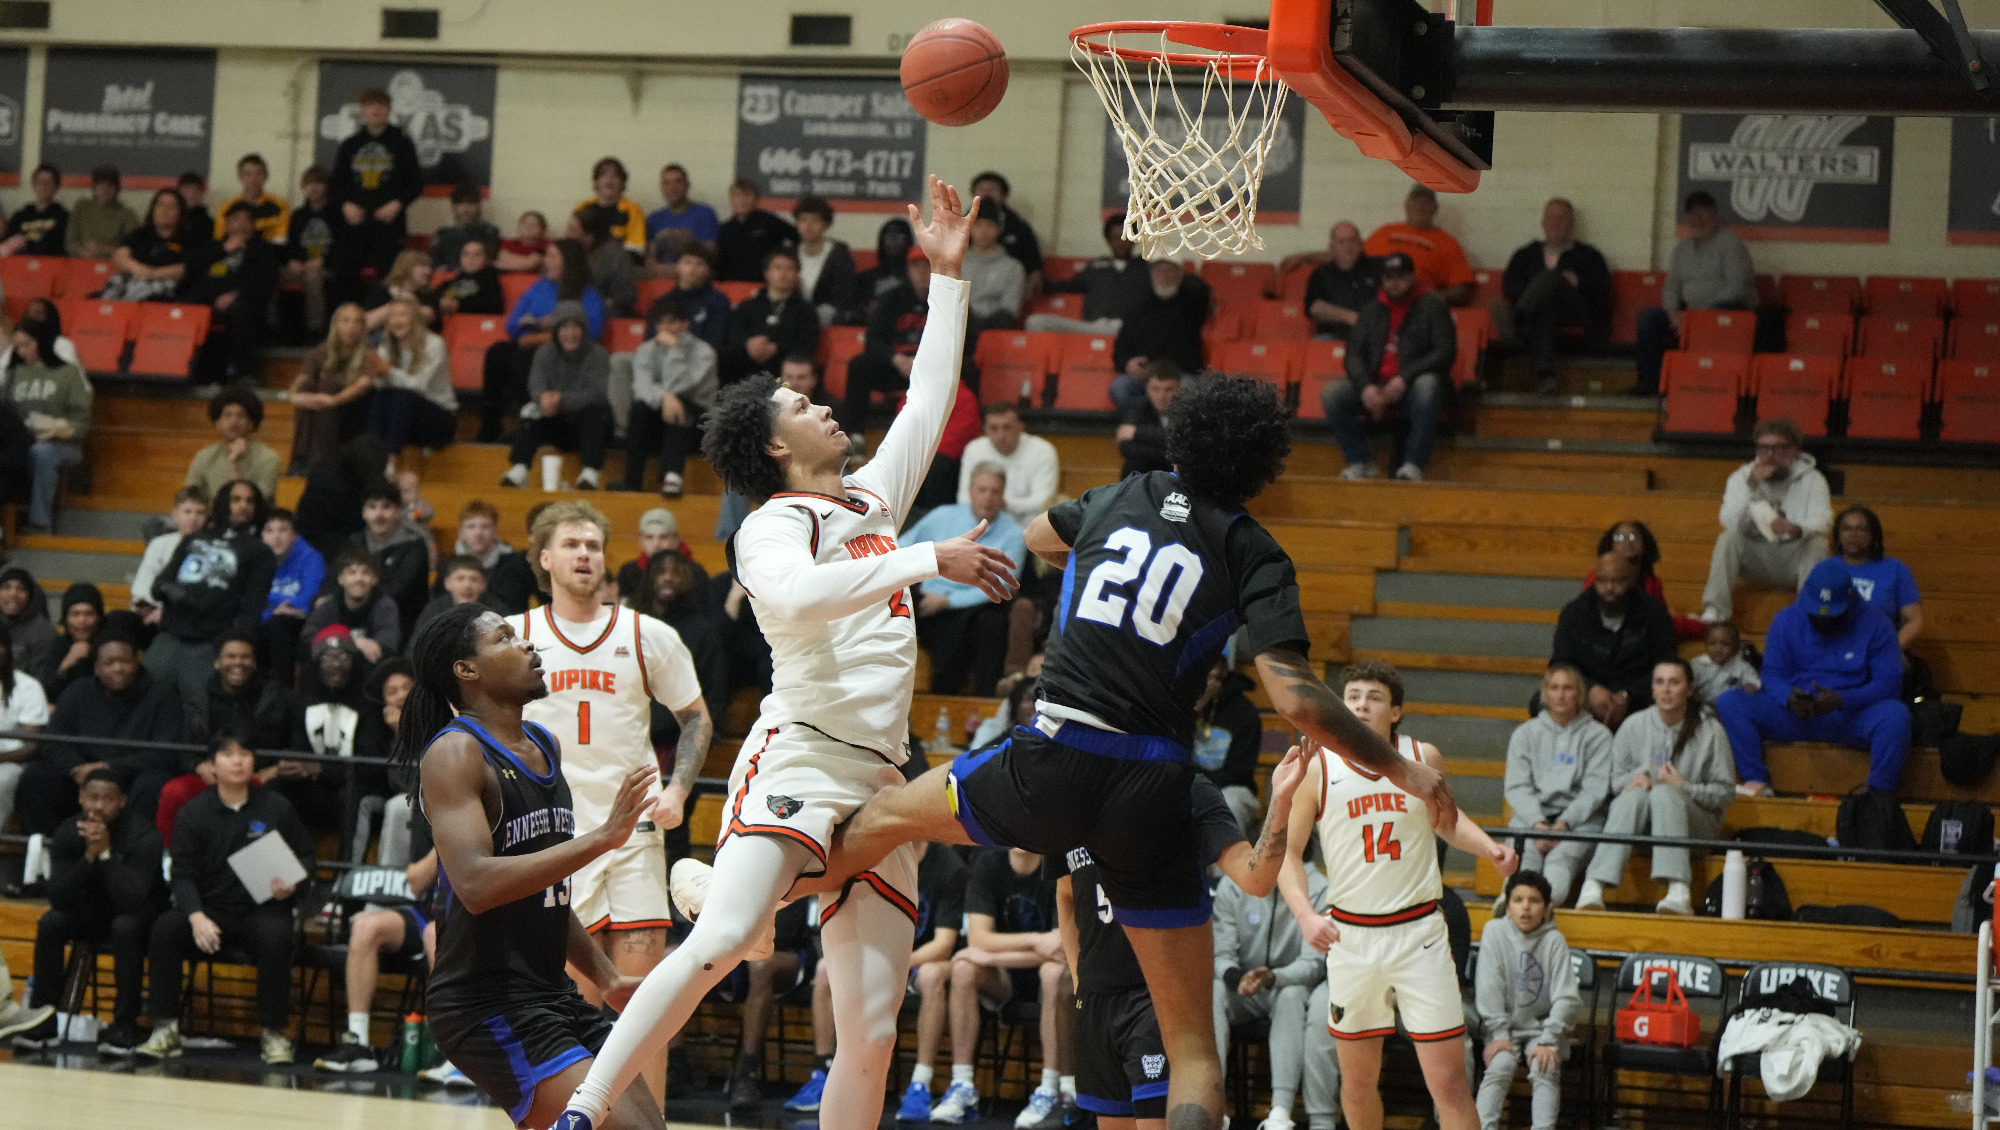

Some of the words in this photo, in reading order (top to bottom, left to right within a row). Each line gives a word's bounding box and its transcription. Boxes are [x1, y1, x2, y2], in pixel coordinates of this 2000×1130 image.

[1711, 154, 1860, 173] WALTERS
[844, 533, 897, 560] UPIKE
[1075, 526, 1204, 647] 20
[551, 669, 616, 695] UPIKE
[577, 701, 590, 745] 1
[1347, 793, 1408, 819] UPIKE
[1362, 821, 1401, 863] 14
[1096, 883, 1114, 924] 5
[1633, 1016, 1650, 1037] G
